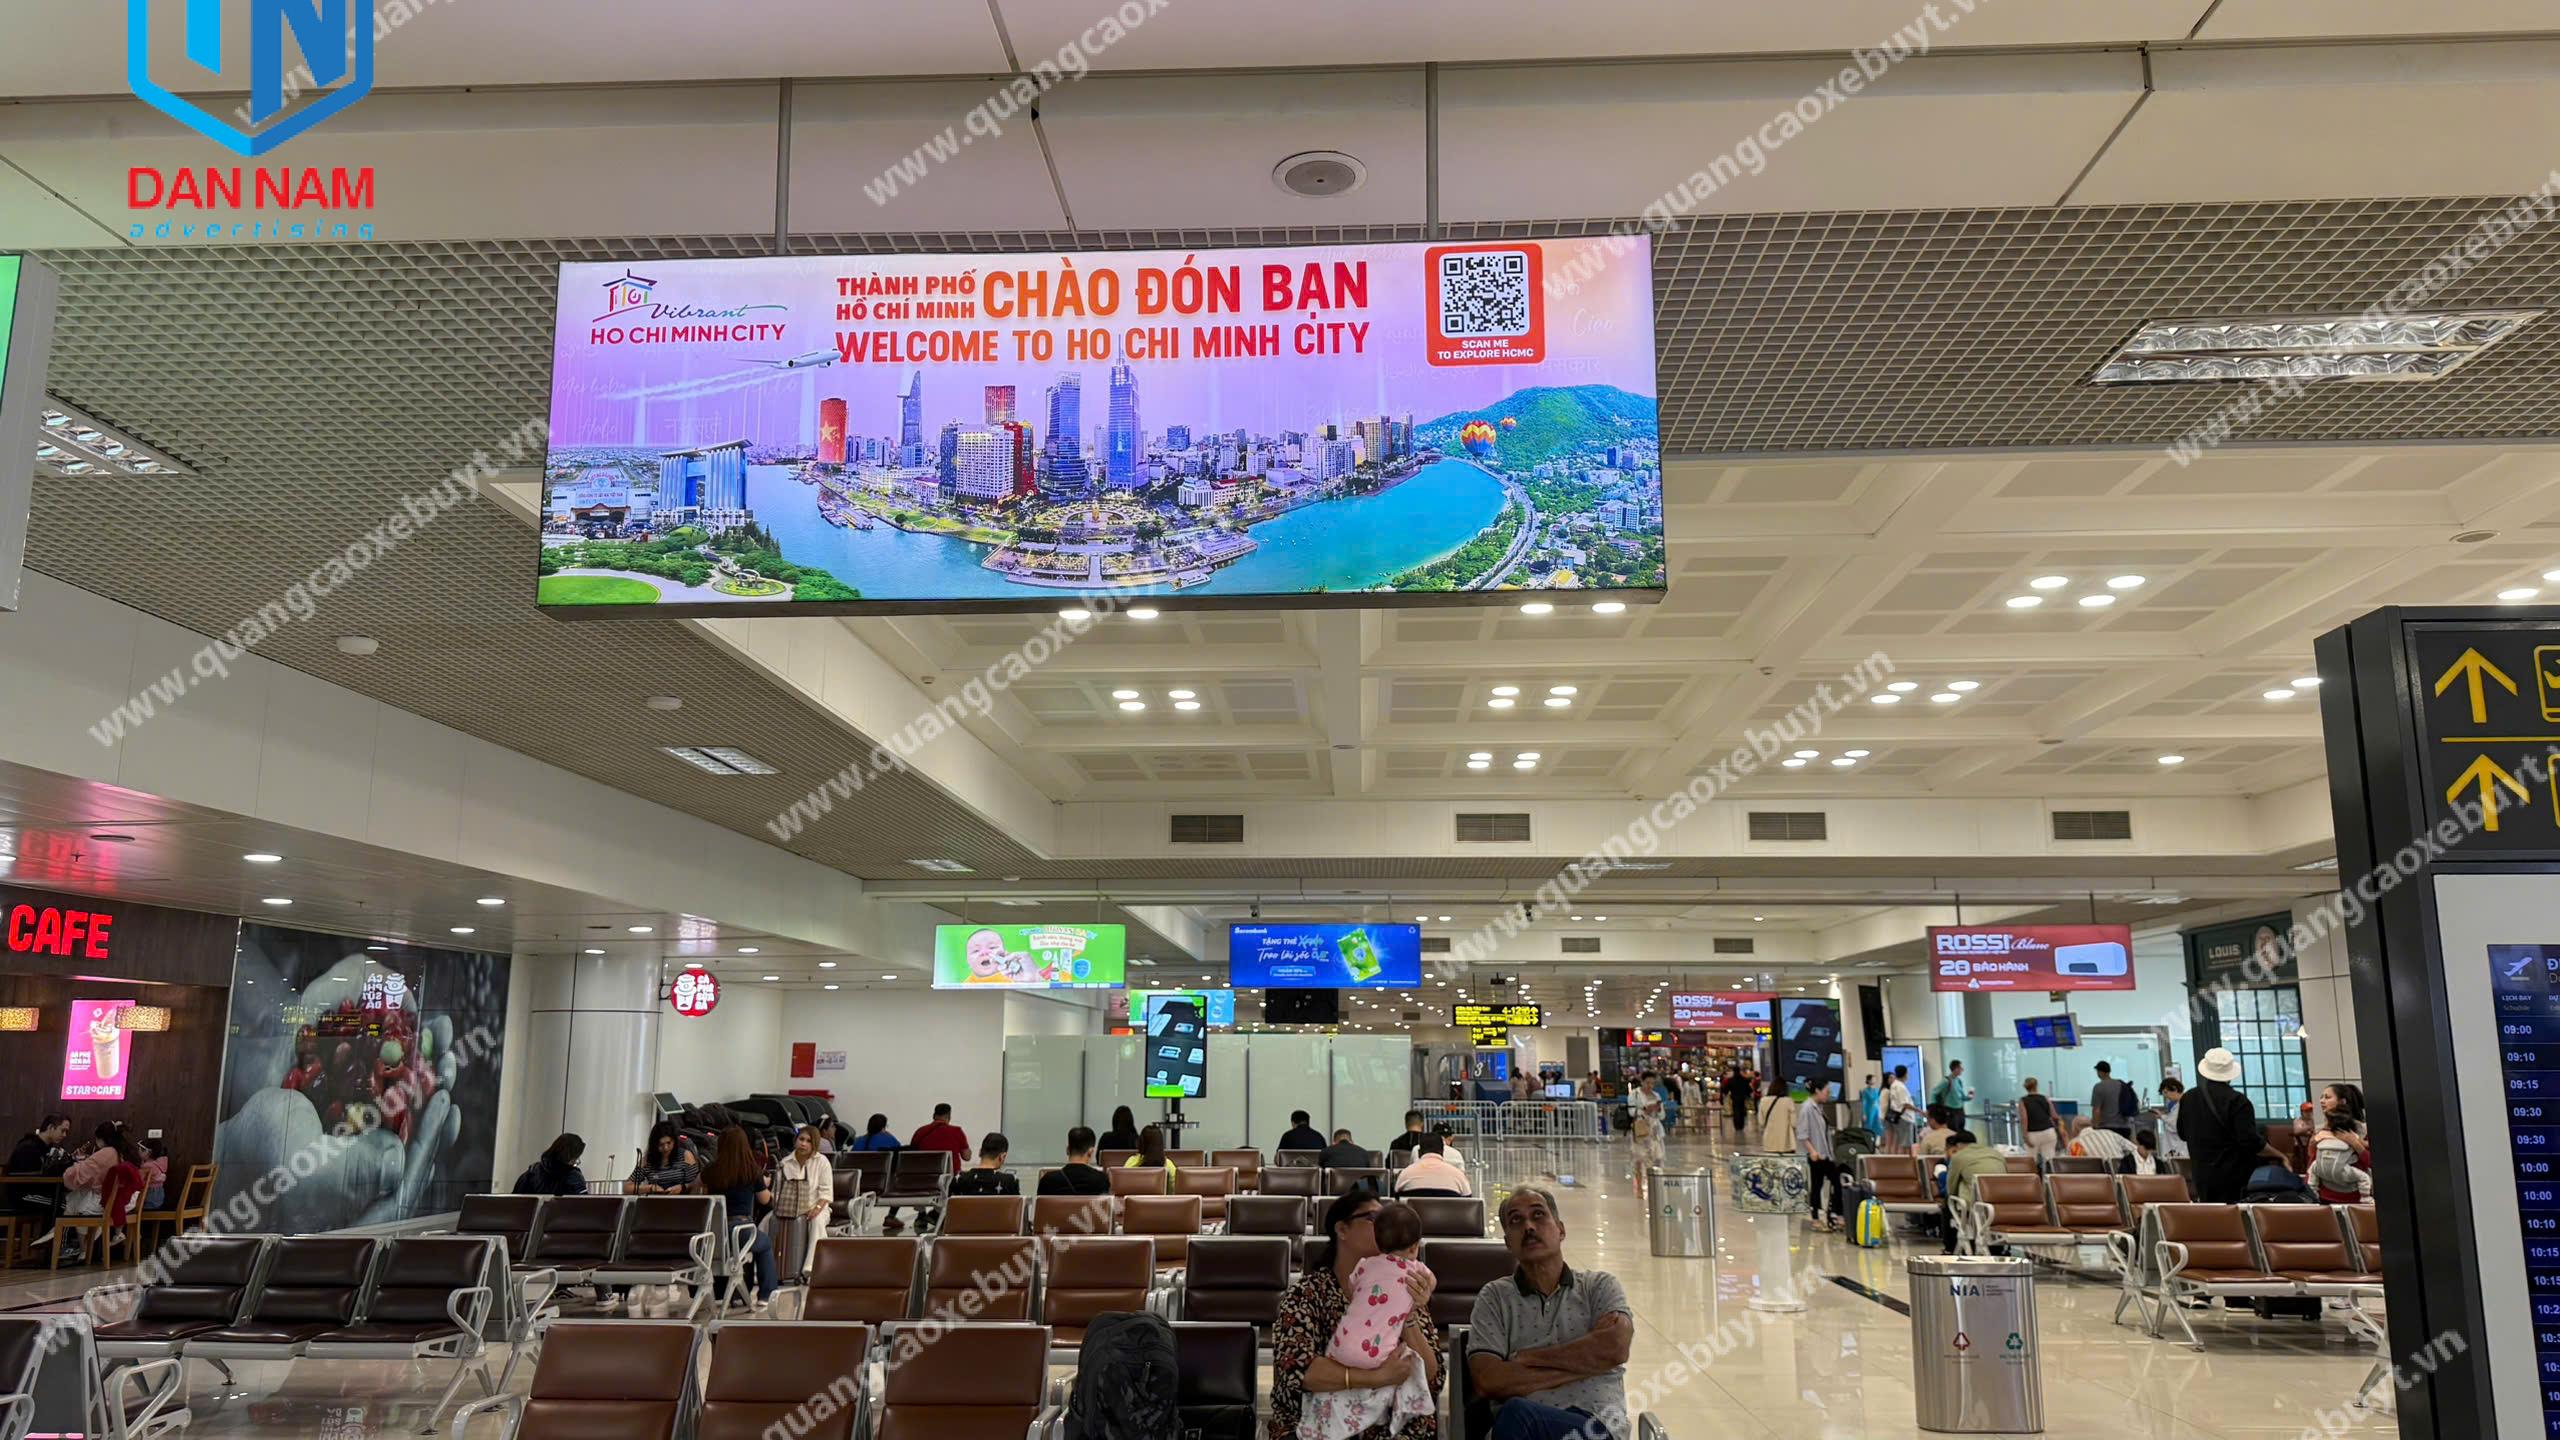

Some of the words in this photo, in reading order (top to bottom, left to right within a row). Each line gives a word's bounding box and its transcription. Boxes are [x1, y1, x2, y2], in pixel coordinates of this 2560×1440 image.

[837, 271, 918, 296] THÀNH
[925, 268, 977, 295] PHỐ
[983, 256, 1120, 318] CHÀO
[1135, 254, 1241, 315] ĐÓN
[1262, 261, 1368, 319] BẠN
[651, 302, 788, 319] Vibrant
[836, 297, 868, 320] HỒ
[873, 298, 910, 320] CHÍ
[916, 302, 975, 319] MINH
[591, 327, 624, 345] HO
[629, 326, 666, 343] CHI
[671, 324, 728, 342] MINH
[731, 323, 786, 341] CITY
[835, 329, 998, 363] WELCOME
[1012, 328, 1053, 361] TO
[1067, 327, 1111, 360] HO
[1125, 327, 1179, 359] CHI
[1193, 324, 1280, 358] MINH
[1294, 322, 1370, 355] CITY
[1461, 339, 1490, 349] SCAN
[1493, 339, 1509, 348] ME
[1437, 350, 1451, 360] TO
[1453, 349, 1499, 359] EXPLORE
[1502, 348, 1534, 358] HCMC
[8, 904, 113, 959] CAFE
[1936, 934, 2010, 950] ROSSI
[2208, 944, 2241, 959] LOUIS
[1673, 995, 1713, 1007] ROSSI
[2504, 1024, 2532, 1034] 09:00
[2507, 1052, 2536, 1062] 09:10
[2510, 1079, 2539, 1089] 09:15
[2513, 1107, 2542, 1117] 09:30
[2517, 1135, 2545, 1145] 09:30
[2520, 1163, 2549, 1173] 10:00
[2524, 1191, 2552, 1201] 10:00
[2527, 1219, 2556, 1229] 10:10
[2531, 1247, 2560, 1257] 10:15
[1950, 1284, 1980, 1297] NIA
[2537, 1304, 2560, 1314] 10:2
